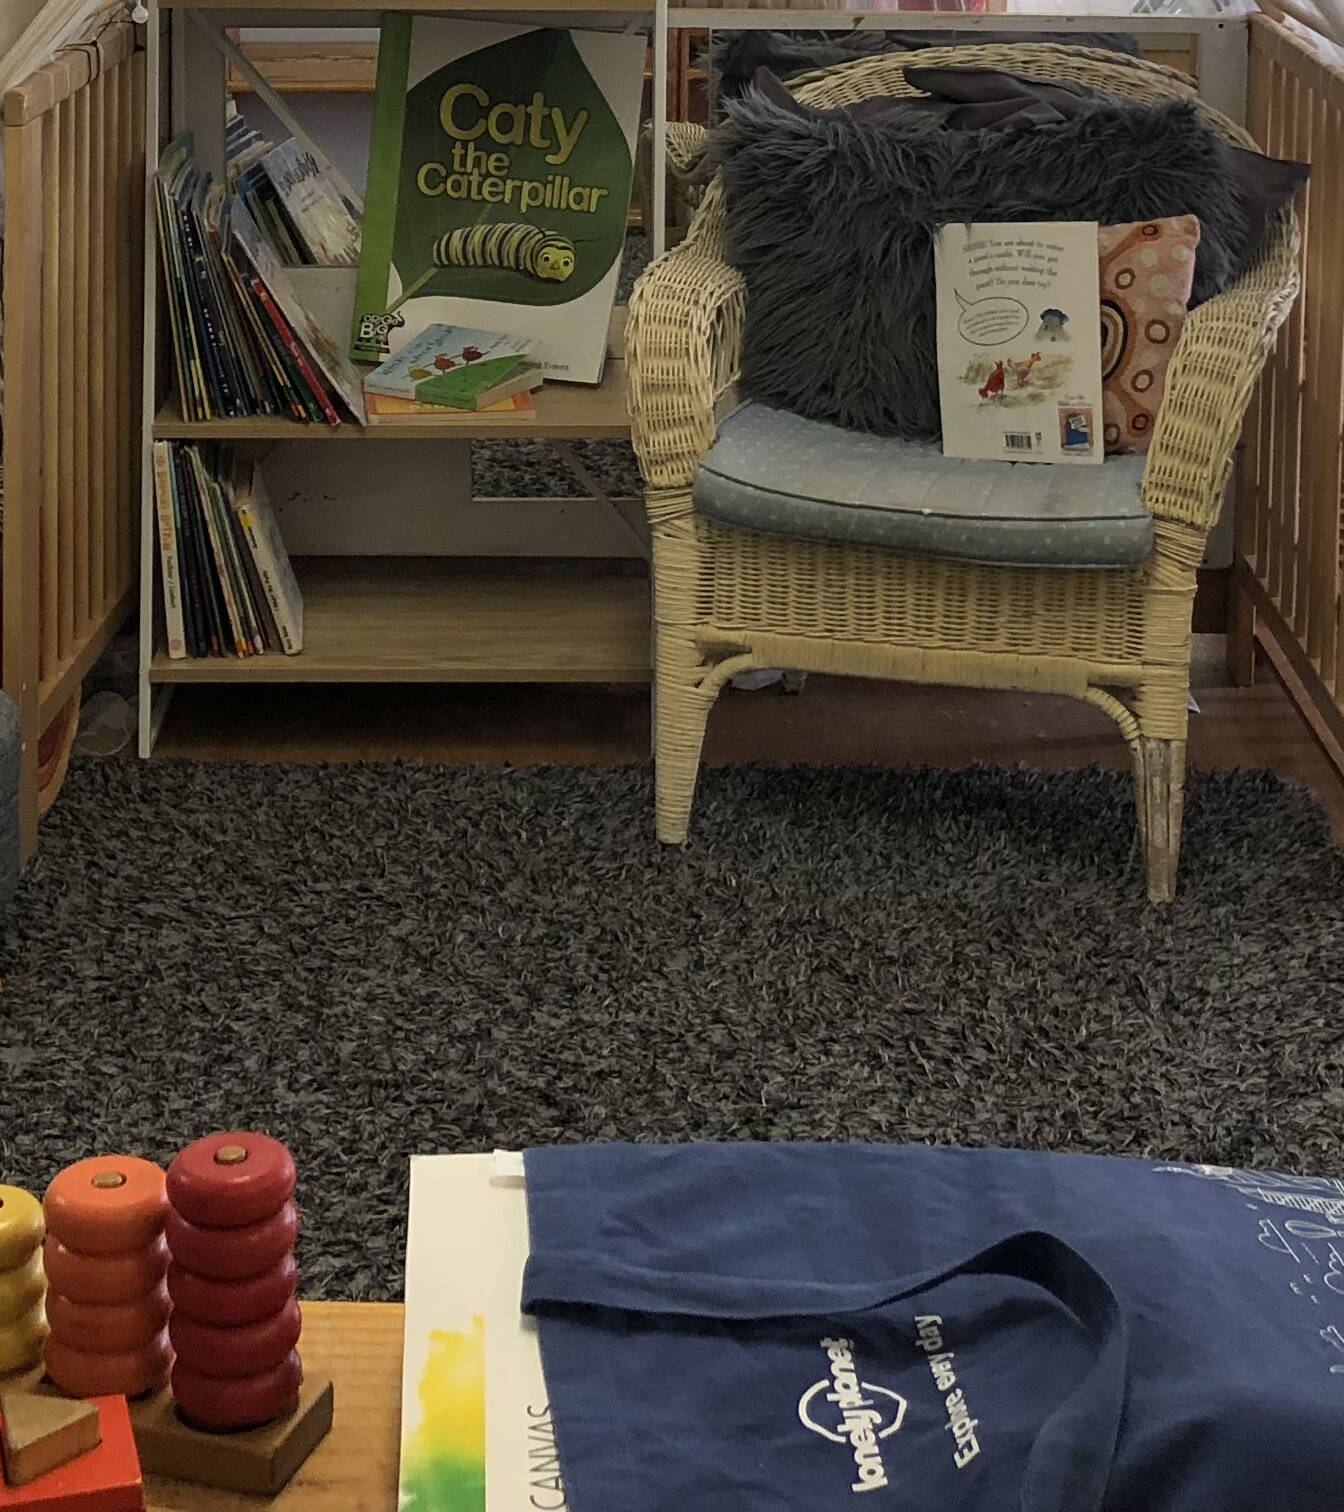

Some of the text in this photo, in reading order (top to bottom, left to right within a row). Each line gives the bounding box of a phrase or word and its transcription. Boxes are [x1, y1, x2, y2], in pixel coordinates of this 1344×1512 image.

[439, 83, 590, 165] Caty
[450, 141, 511, 175] the
[416, 161, 609, 216] Caterpillar
[913, 1314, 981, 1470] Explore every day
[526, 1404, 567, 1511] CANVAS
[836, 1408, 889, 1492] lonely
